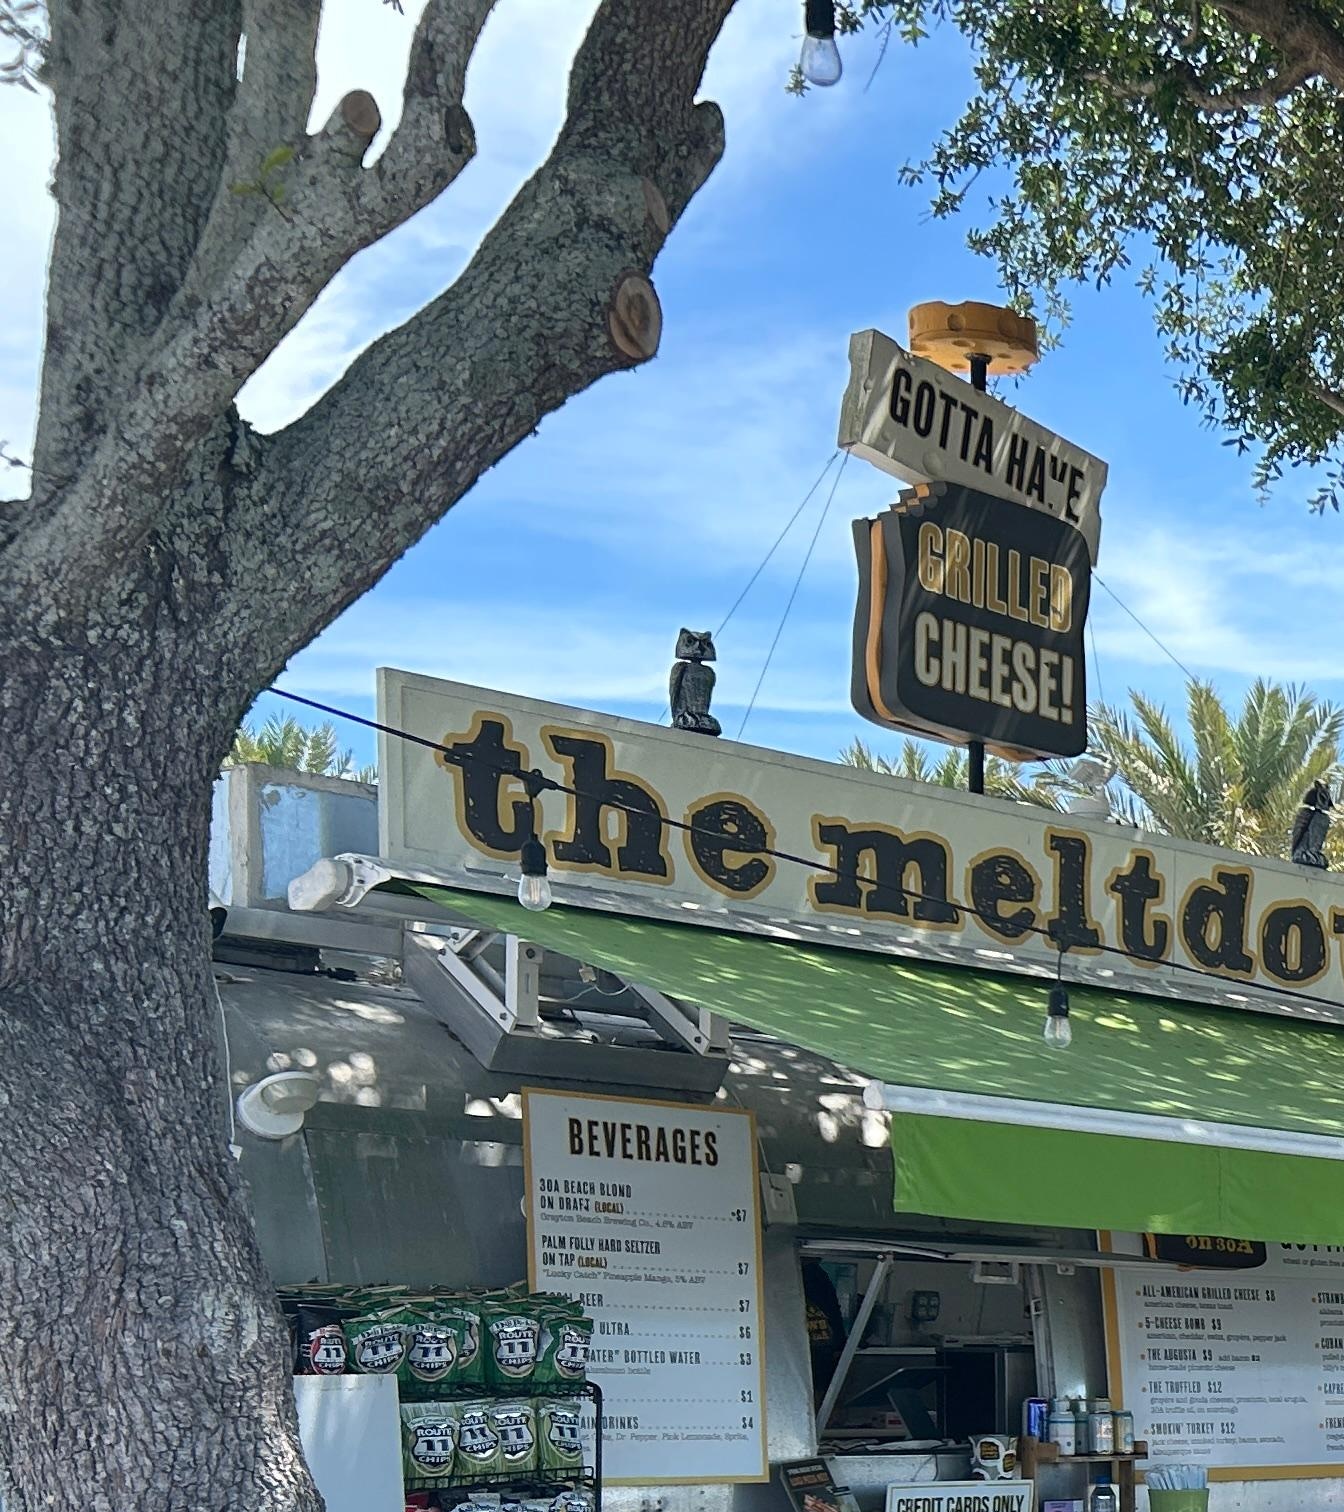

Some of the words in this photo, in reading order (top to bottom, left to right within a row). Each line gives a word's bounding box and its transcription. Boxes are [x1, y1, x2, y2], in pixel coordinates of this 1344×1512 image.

[889, 367, 994, 475] GOTTA
[918, 521, 1073, 633] GRILLED
[914, 611, 1074, 725] CHEESE!
[438, 712, 774, 897] the
[568, 1117, 719, 1167] BEVERAGES
[540, 1178, 560, 1193] 30A
[564, 1179, 596, 1196] BEACH
[600, 1182, 632, 1198] BLOND
[540, 1196, 554, 1210] ON
[559, 1197, 590, 1212] DRAFT
[594, 1201, 625, 1215] (LOCAL)
[542, 1235, 566, 1250] PALM
[570, 1237, 595, 1251] FOLLY
[598, 1239, 622, 1253] HARD
[625, 1240, 661, 1255] SELTZER
[1185, 1235, 1214, 1250] on
[1215, 1237, 1254, 1255] 30A
[542, 1252, 556, 1266] ON
[560, 1253, 576, 1267] TAP
[578, 1256, 608, 1269] (LOCAL)
[738, 1263, 749, 1276] $7
[1142, 1285, 1199, 1299] ALL-AMERICAN
[1201, 1287, 1232, 1301] GRILLED
[1233, 1288, 1260, 1302] CHEESE
[579, 1292, 604, 1307] BEER
[739, 1299, 750, 1313] $7
[1145, 1316, 1182, 1330] 5-CHEESE
[499, 1330, 534, 1340] ROUTE
[600, 1322, 630, 1336] ULTRA
[739, 1326, 751, 1339] $6
[323, 1347, 341, 1358] 11
[418, 1346, 443, 1358] 11
[503, 1341, 530, 1354] 11
[501, 1357, 534, 1365] CHIPS
[625, 1350, 666, 1364] BOTTLED
[669, 1351, 701, 1365] WATER
[740, 1353, 751, 1366] $3
[1147, 1348, 1162, 1361] THE
[1164, 1349, 1197, 1362] AUGUSTA
[1202, 1349, 1213, 1362] $9
[1149, 1381, 1163, 1394] THE
[1164, 1381, 1202, 1394] TRUFFLED
[1207, 1381, 1223, 1394] $12
[740, 1390, 753, 1403] $1
[603, 1416, 639, 1430] DRINKS
[742, 1416, 754, 1430] $4
[1150, 1422, 1184, 1435] SMOKIN'
[1186, 1422, 1215, 1435] TURKEY
[1220, 1422, 1236, 1435] $12
[464, 1427, 488, 1440] 11
[500, 1427, 524, 1441] 11
[556, 1426, 578, 1439] 11
[421, 1439, 449, 1451] 11
[465, 1441, 497, 1452] CHIPS
